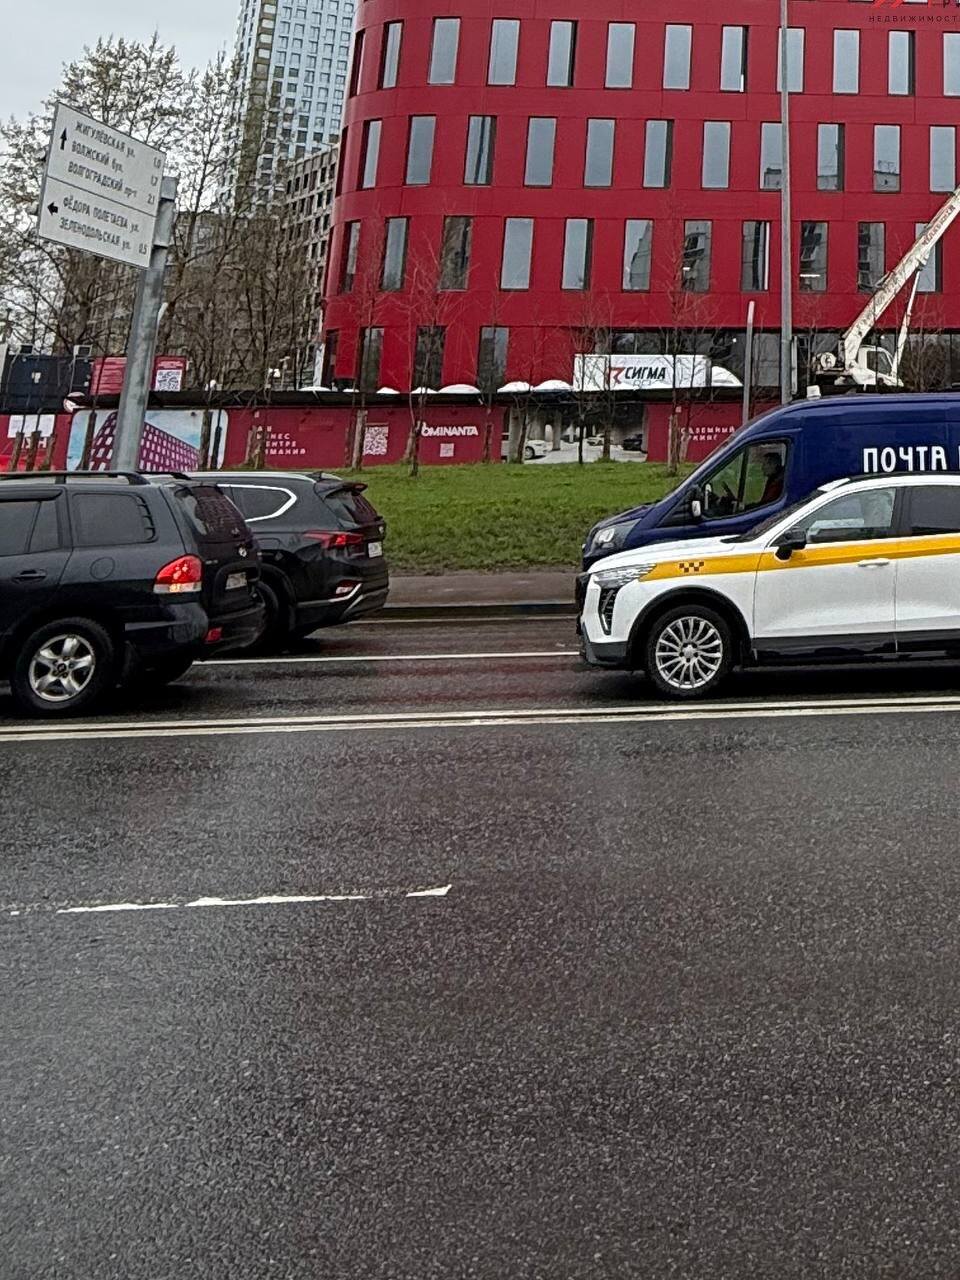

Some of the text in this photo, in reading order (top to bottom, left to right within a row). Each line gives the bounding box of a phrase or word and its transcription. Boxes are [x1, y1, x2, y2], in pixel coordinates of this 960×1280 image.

[71, 141, 110, 166] ВОЛЖСКИЙ
[68, 161, 123, 193] ВОЛГОГРАДСКИЙ
[625, 366, 666, 380] СИГМА
[260, 440, 297, 448] ЕНТРЕ
[863, 446, 947, 473] ПОЧТА
